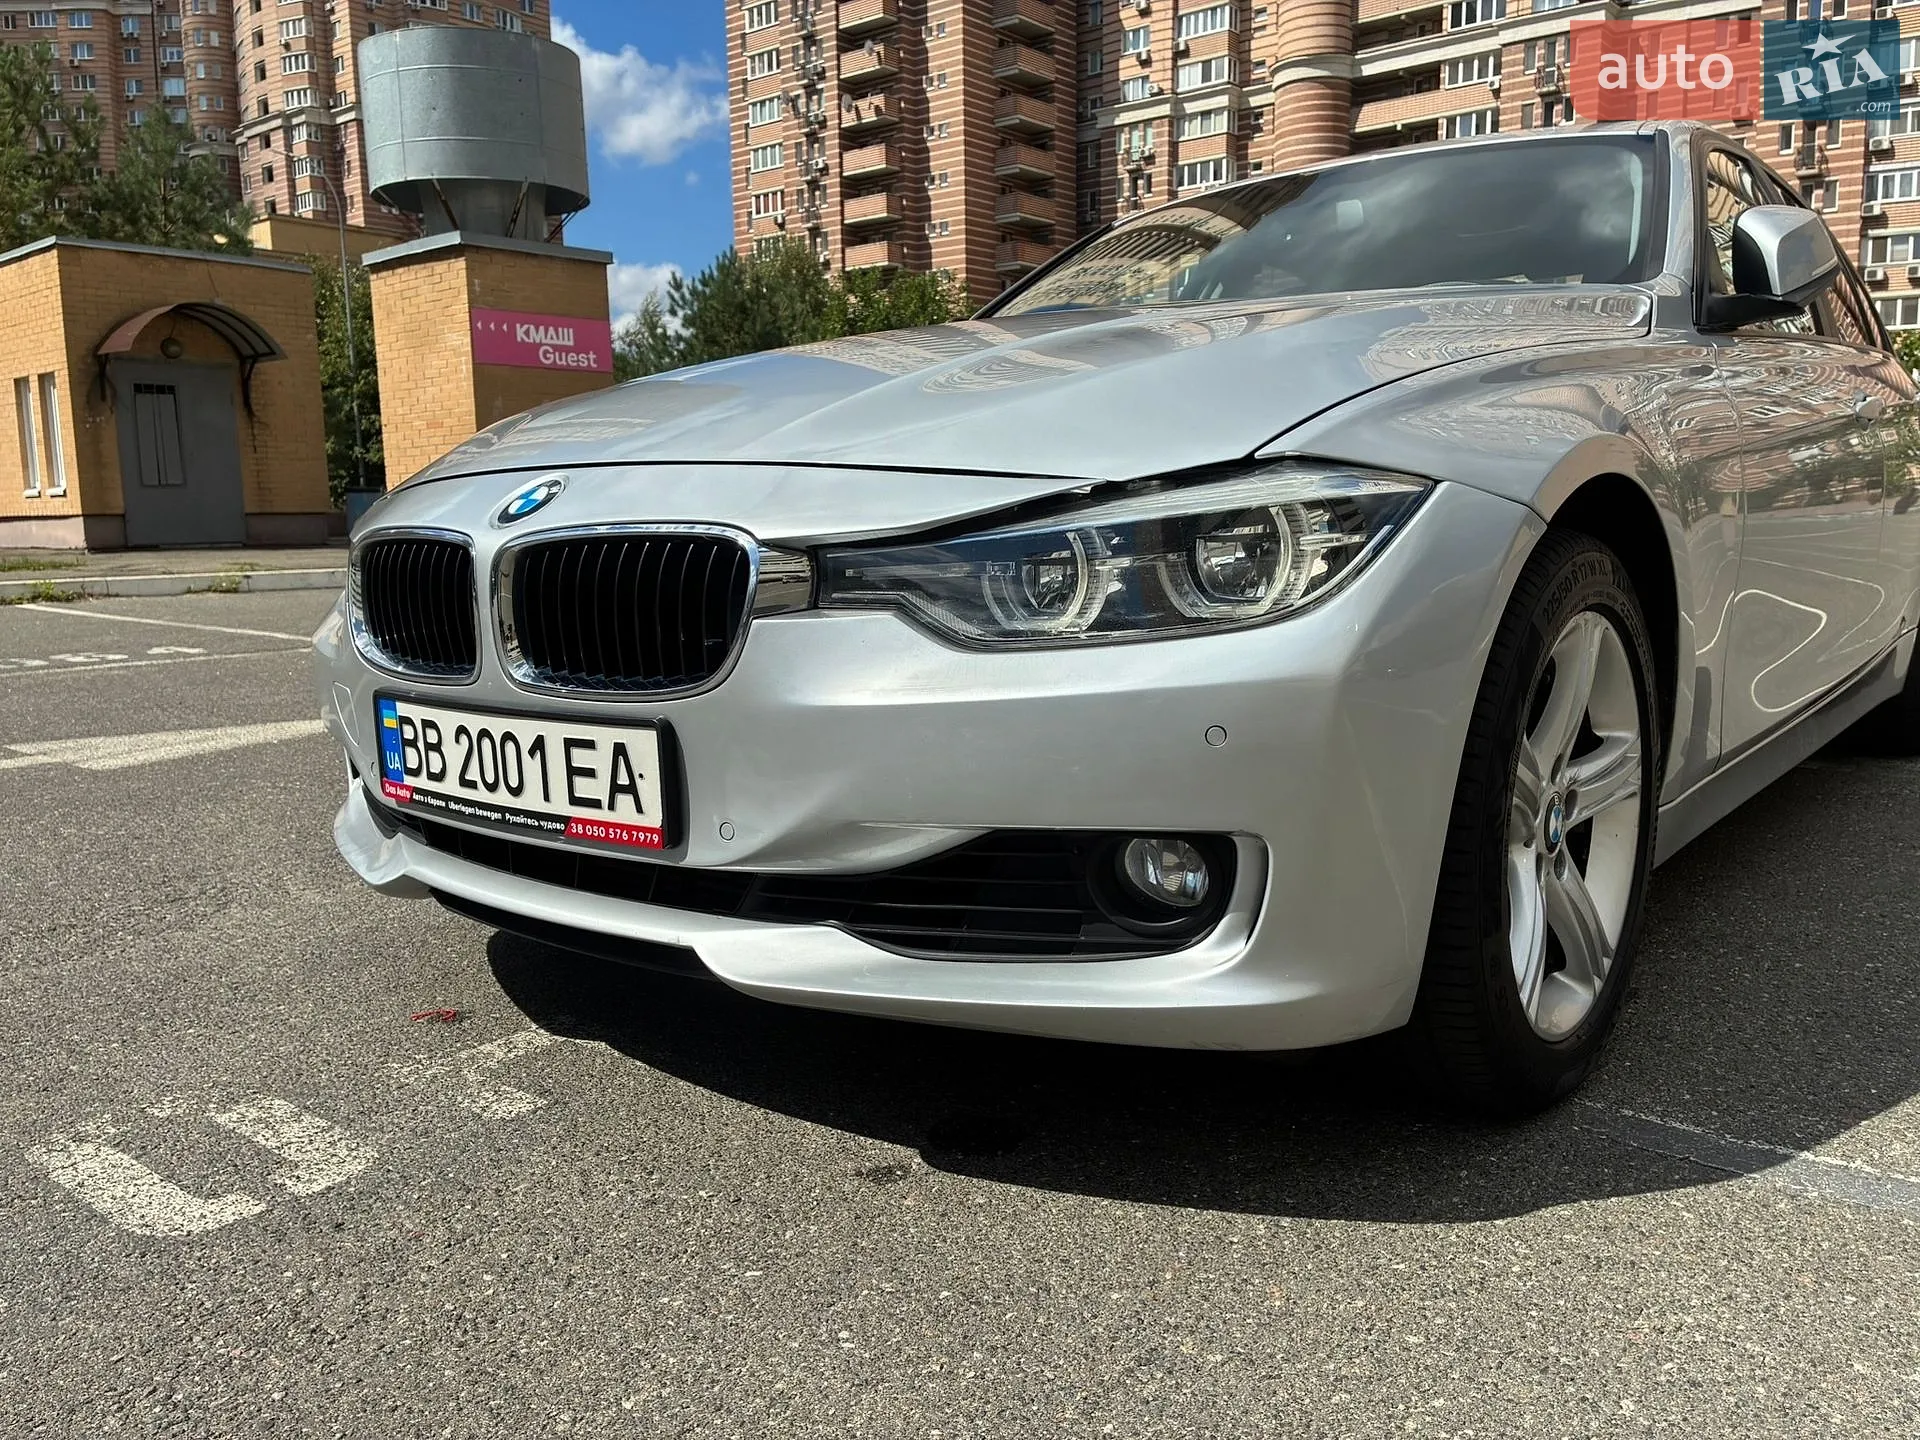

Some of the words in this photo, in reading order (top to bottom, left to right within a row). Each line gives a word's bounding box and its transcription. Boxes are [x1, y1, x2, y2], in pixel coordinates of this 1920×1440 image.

[538, 346, 597, 368] Guest
[387, 751, 401, 771] UA
[454, 724, 551, 804] 2001
[571, 823, 583, 834] 38
[585, 825, 606, 838] 050
[608, 828, 629, 841] 576
[631, 830, 659, 845] 7979
